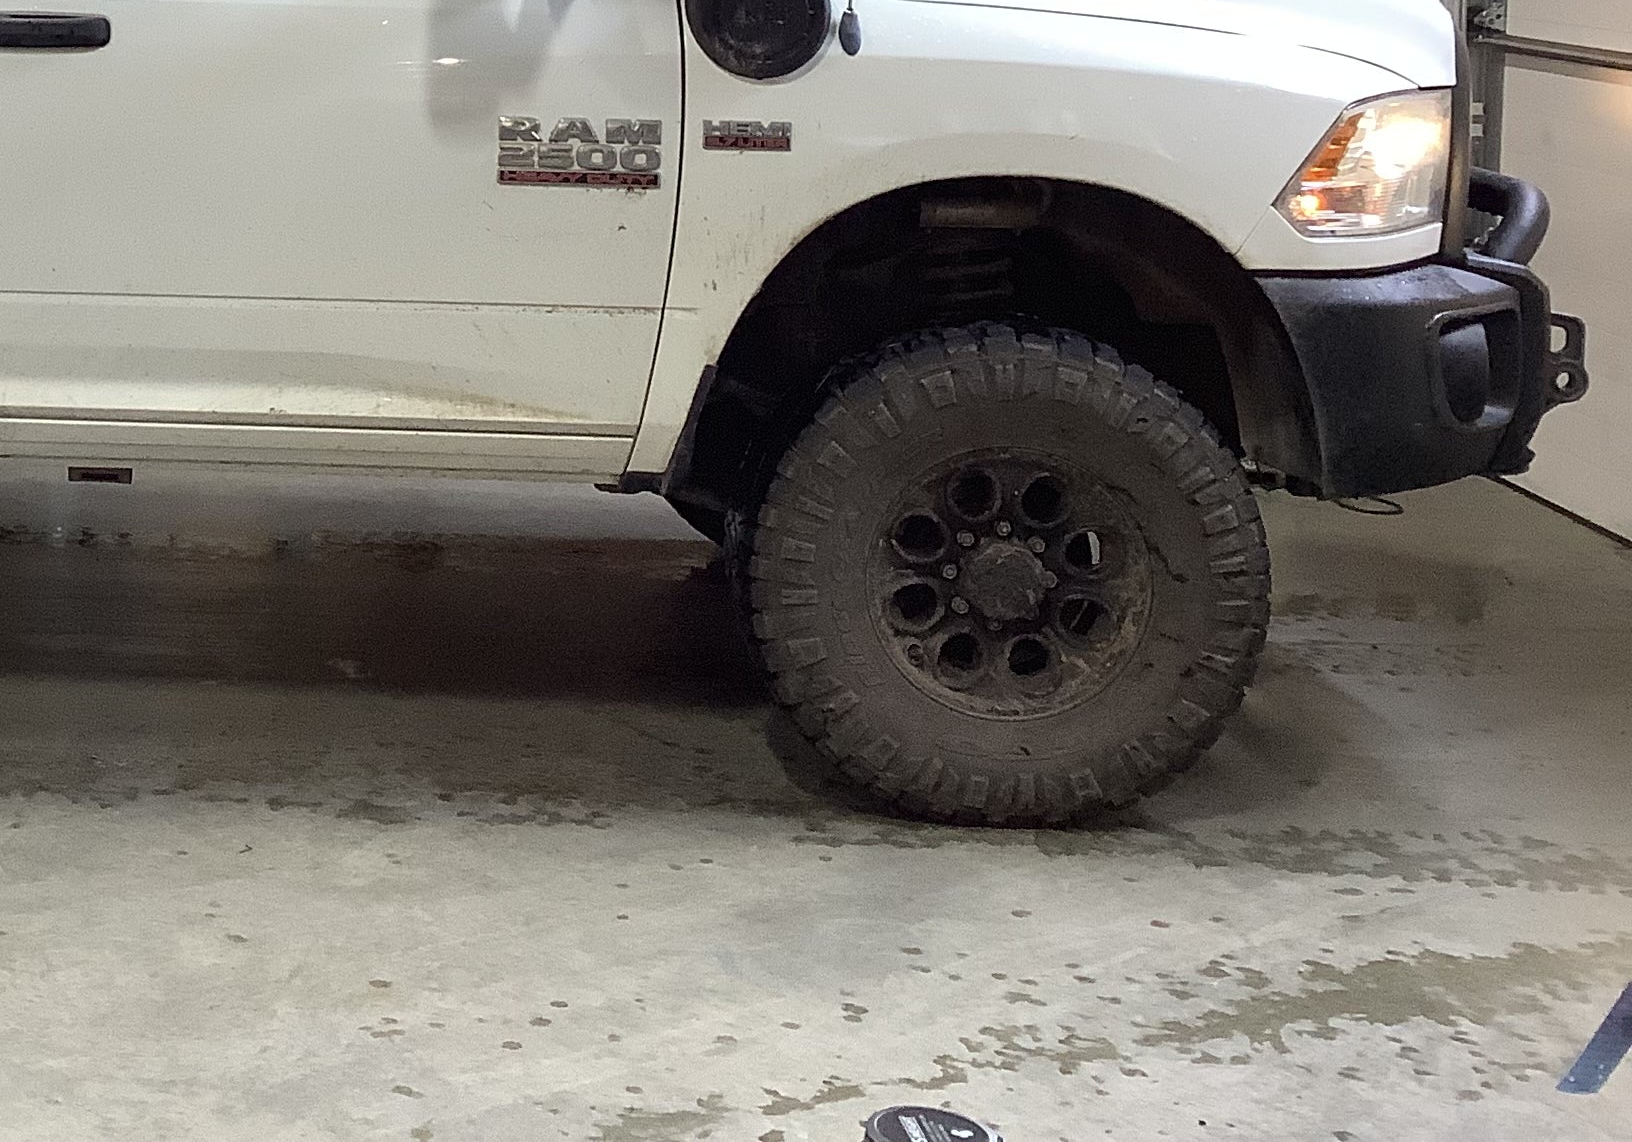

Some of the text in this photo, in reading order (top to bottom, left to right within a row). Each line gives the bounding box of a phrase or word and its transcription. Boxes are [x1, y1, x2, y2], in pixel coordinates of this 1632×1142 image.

[498, 115, 662, 145] RAM
[702, 120, 792, 136] HEMI
[498, 142, 661, 171] 2500
